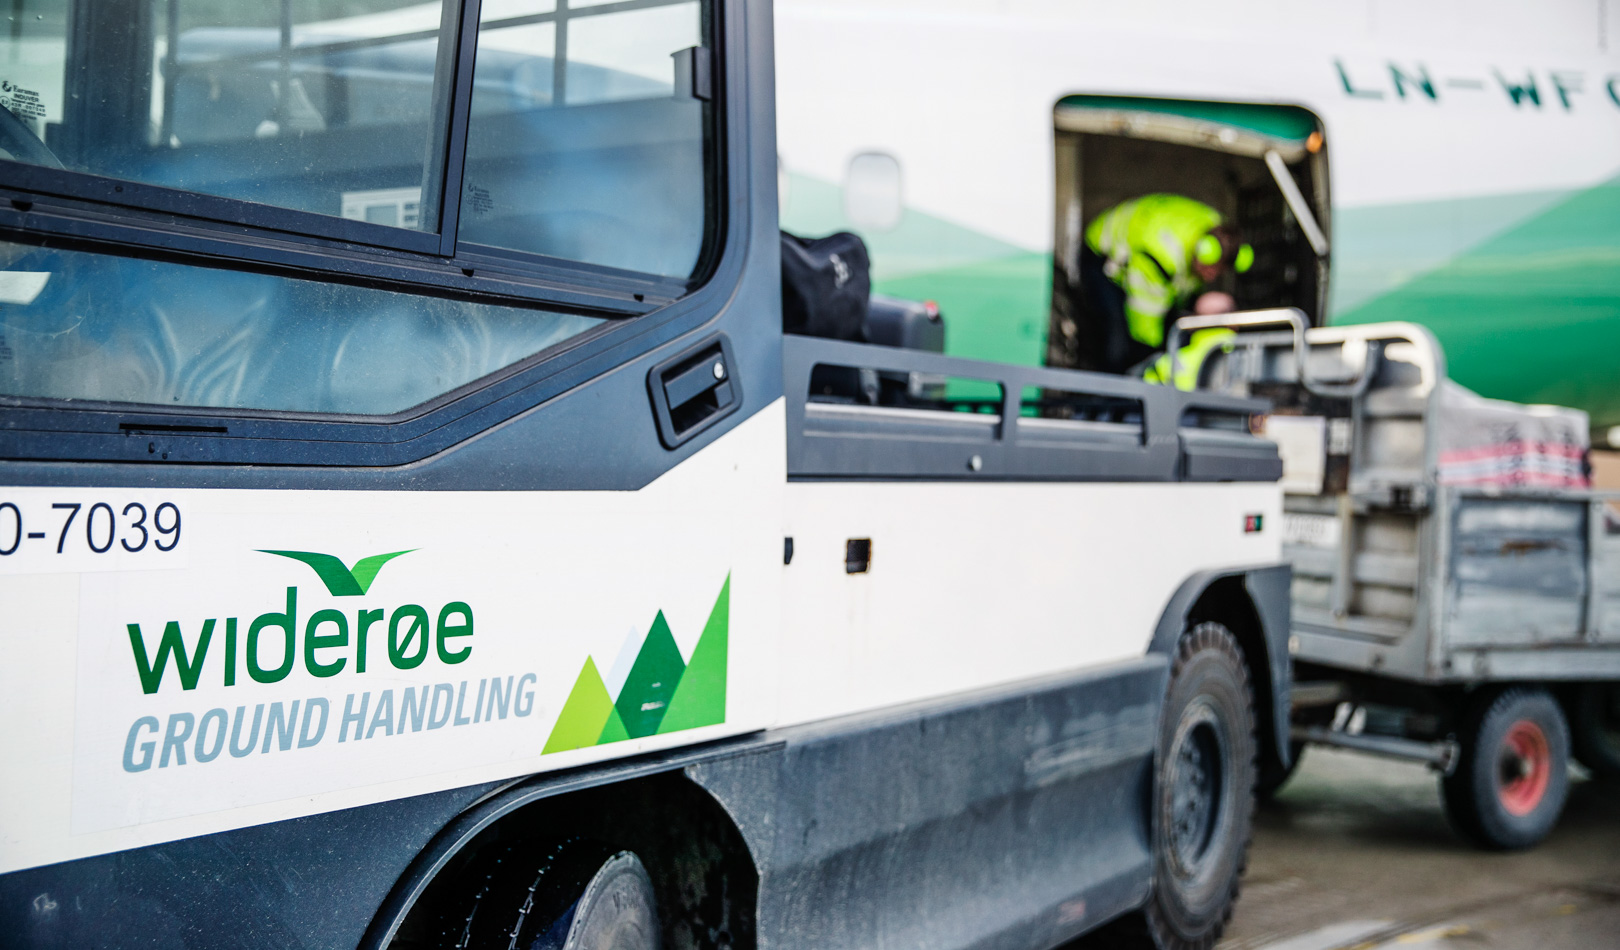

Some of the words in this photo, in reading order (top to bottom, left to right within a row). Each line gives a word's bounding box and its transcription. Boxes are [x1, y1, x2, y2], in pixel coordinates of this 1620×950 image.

[0, 502, 181, 556] 0-7039
[126, 586, 474, 695] widerøe
[122, 697, 329, 773] GROUND
[337, 673, 537, 743] HANDLING
